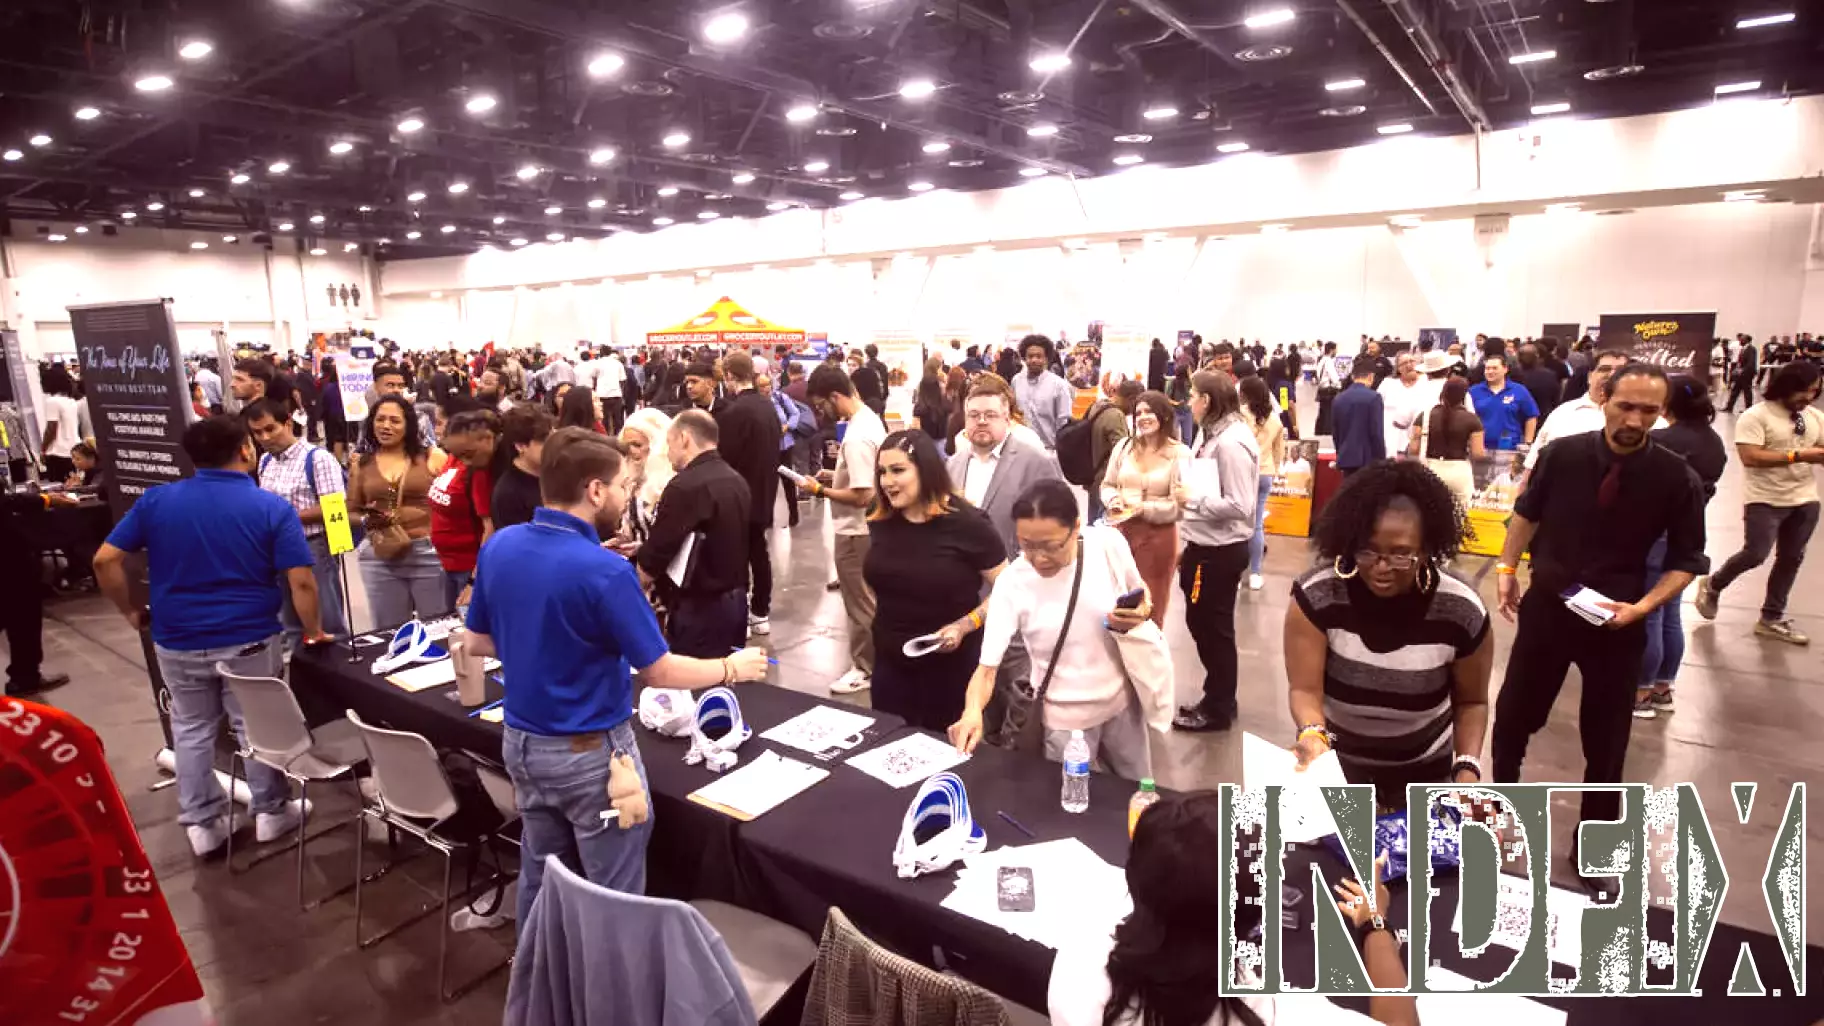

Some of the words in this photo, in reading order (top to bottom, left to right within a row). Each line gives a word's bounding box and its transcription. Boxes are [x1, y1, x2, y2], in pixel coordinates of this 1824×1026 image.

[149, 344, 170, 374] Life
[329, 511, 344, 523] 44
[0, 701, 41, 735] 23
[40, 730, 79, 763] 10
[120, 908, 150, 919] 1
[108, 932, 142, 961] 20
[86, 966, 125, 991] 14
[58, 995, 100, 1022] 31
